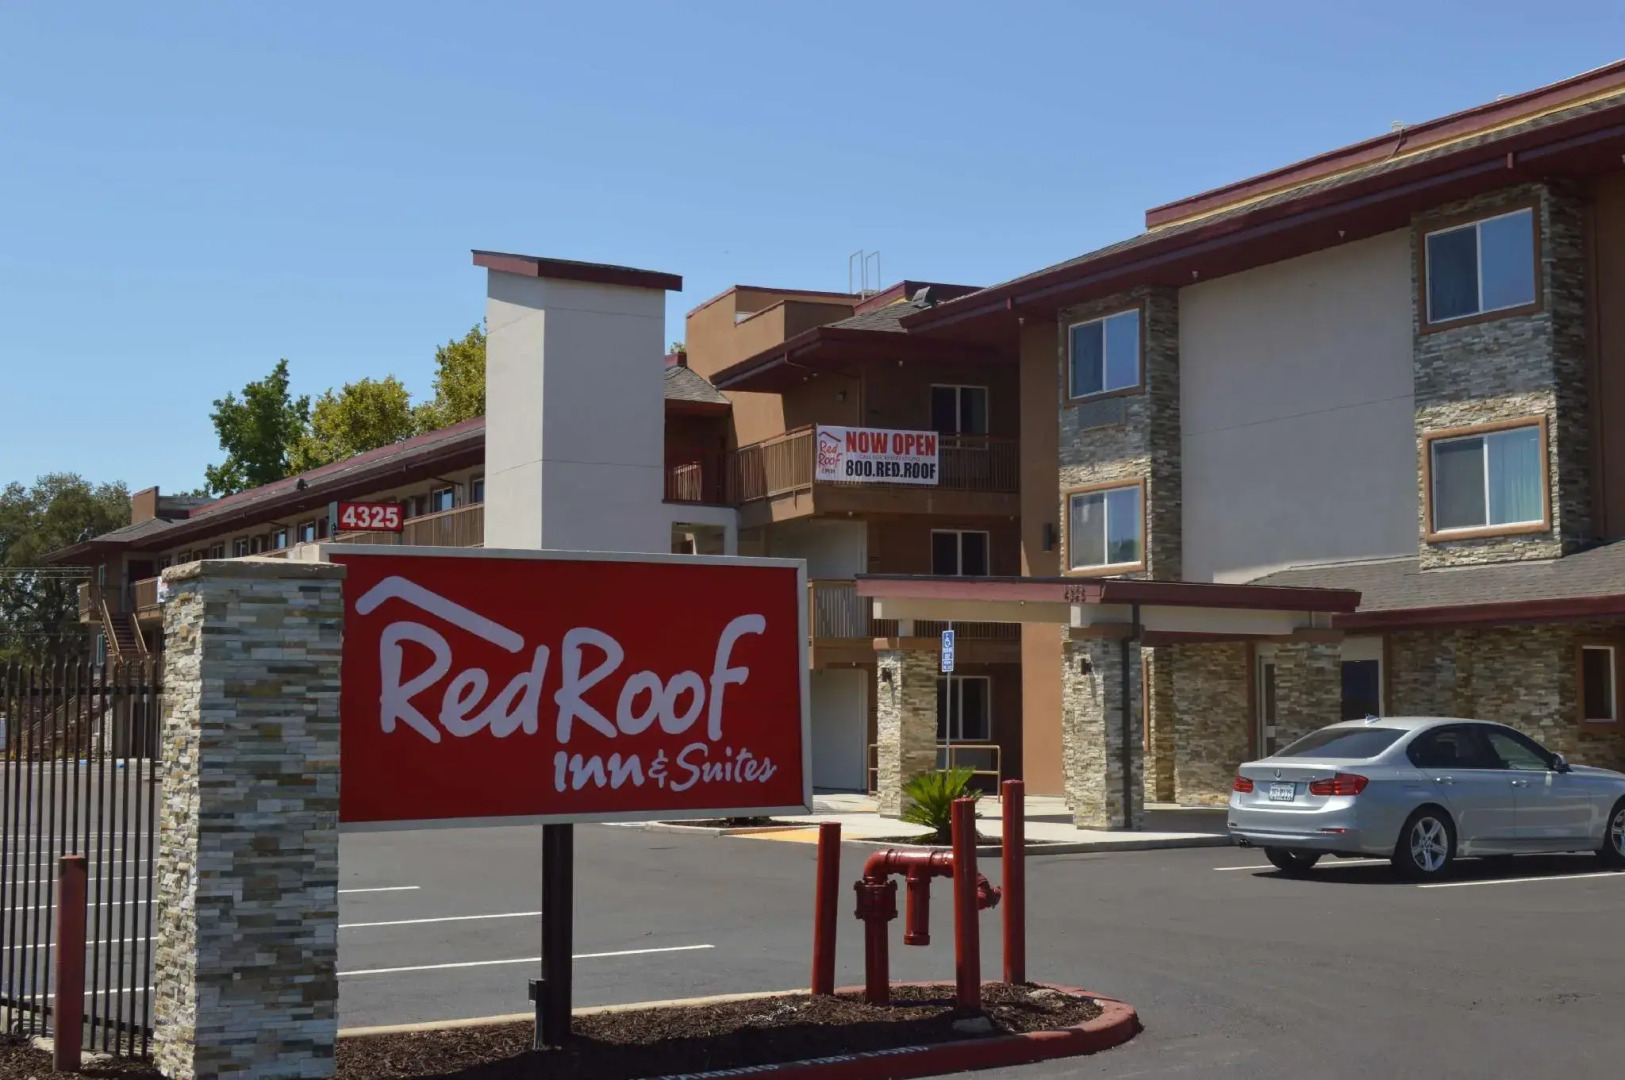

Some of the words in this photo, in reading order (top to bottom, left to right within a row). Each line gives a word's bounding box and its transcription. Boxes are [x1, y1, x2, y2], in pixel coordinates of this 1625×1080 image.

[820, 440, 838, 454] Red
[845, 431, 887, 453] NOW
[893, 433, 936, 457] OPEN
[818, 450, 842, 468] Roof
[846, 459, 936, 479] 800.RED.ROOF
[342, 506, 399, 528] 4325
[380, 621, 550, 743] Red
[554, 614, 766, 744] Roof
[648, 750, 669, 788] &
[670, 742, 778, 792] Suites
